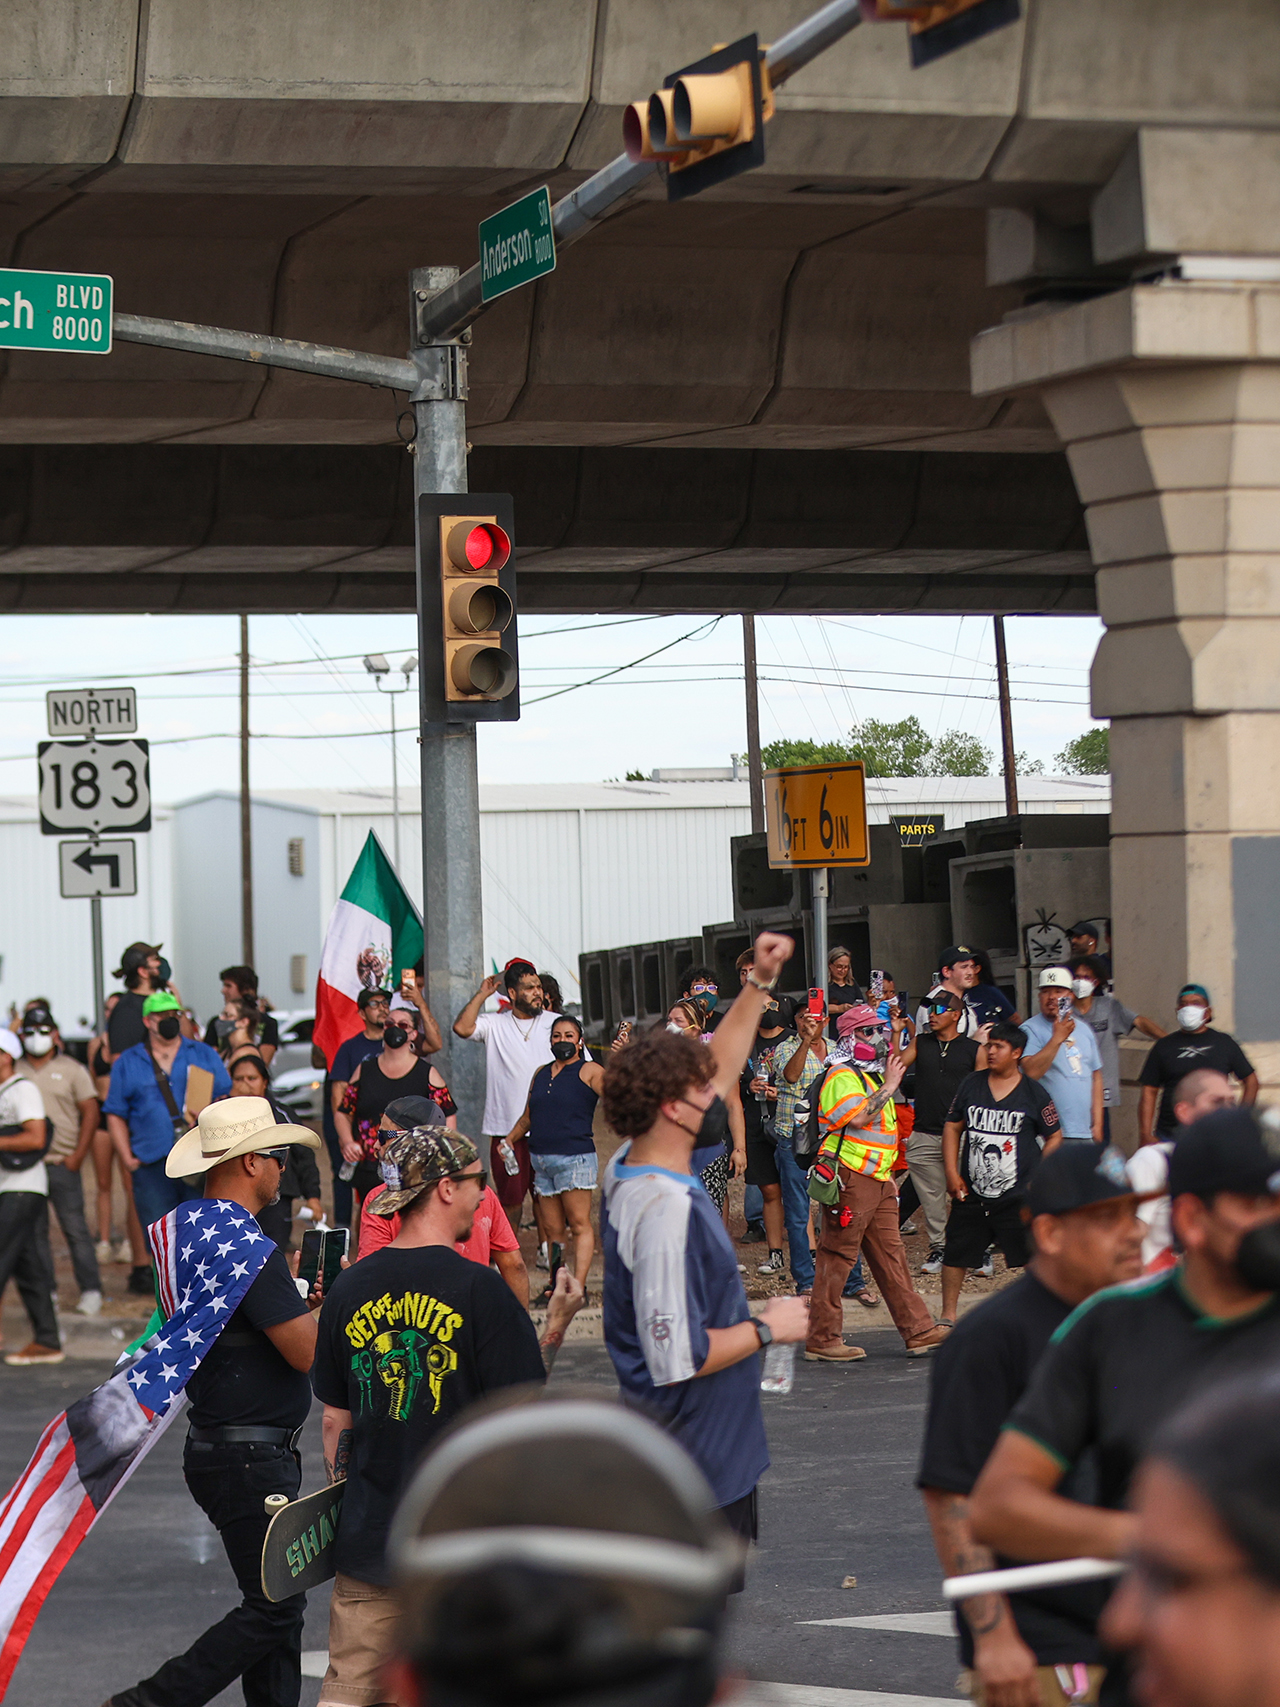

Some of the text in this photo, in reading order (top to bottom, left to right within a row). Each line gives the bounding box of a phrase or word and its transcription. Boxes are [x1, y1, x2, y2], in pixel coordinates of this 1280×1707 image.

[483, 228, 532, 282] Anderson
[56, 284, 104, 310] BLVD
[52, 315, 103, 342] 8000
[53, 698, 131, 726] NORTH
[50, 760, 138, 810] 183
[900, 824, 935, 835] PARTS
[967, 1105, 1026, 1134] SCARFACE
[345, 1291, 464, 1348] GET OFF MY NUTS
